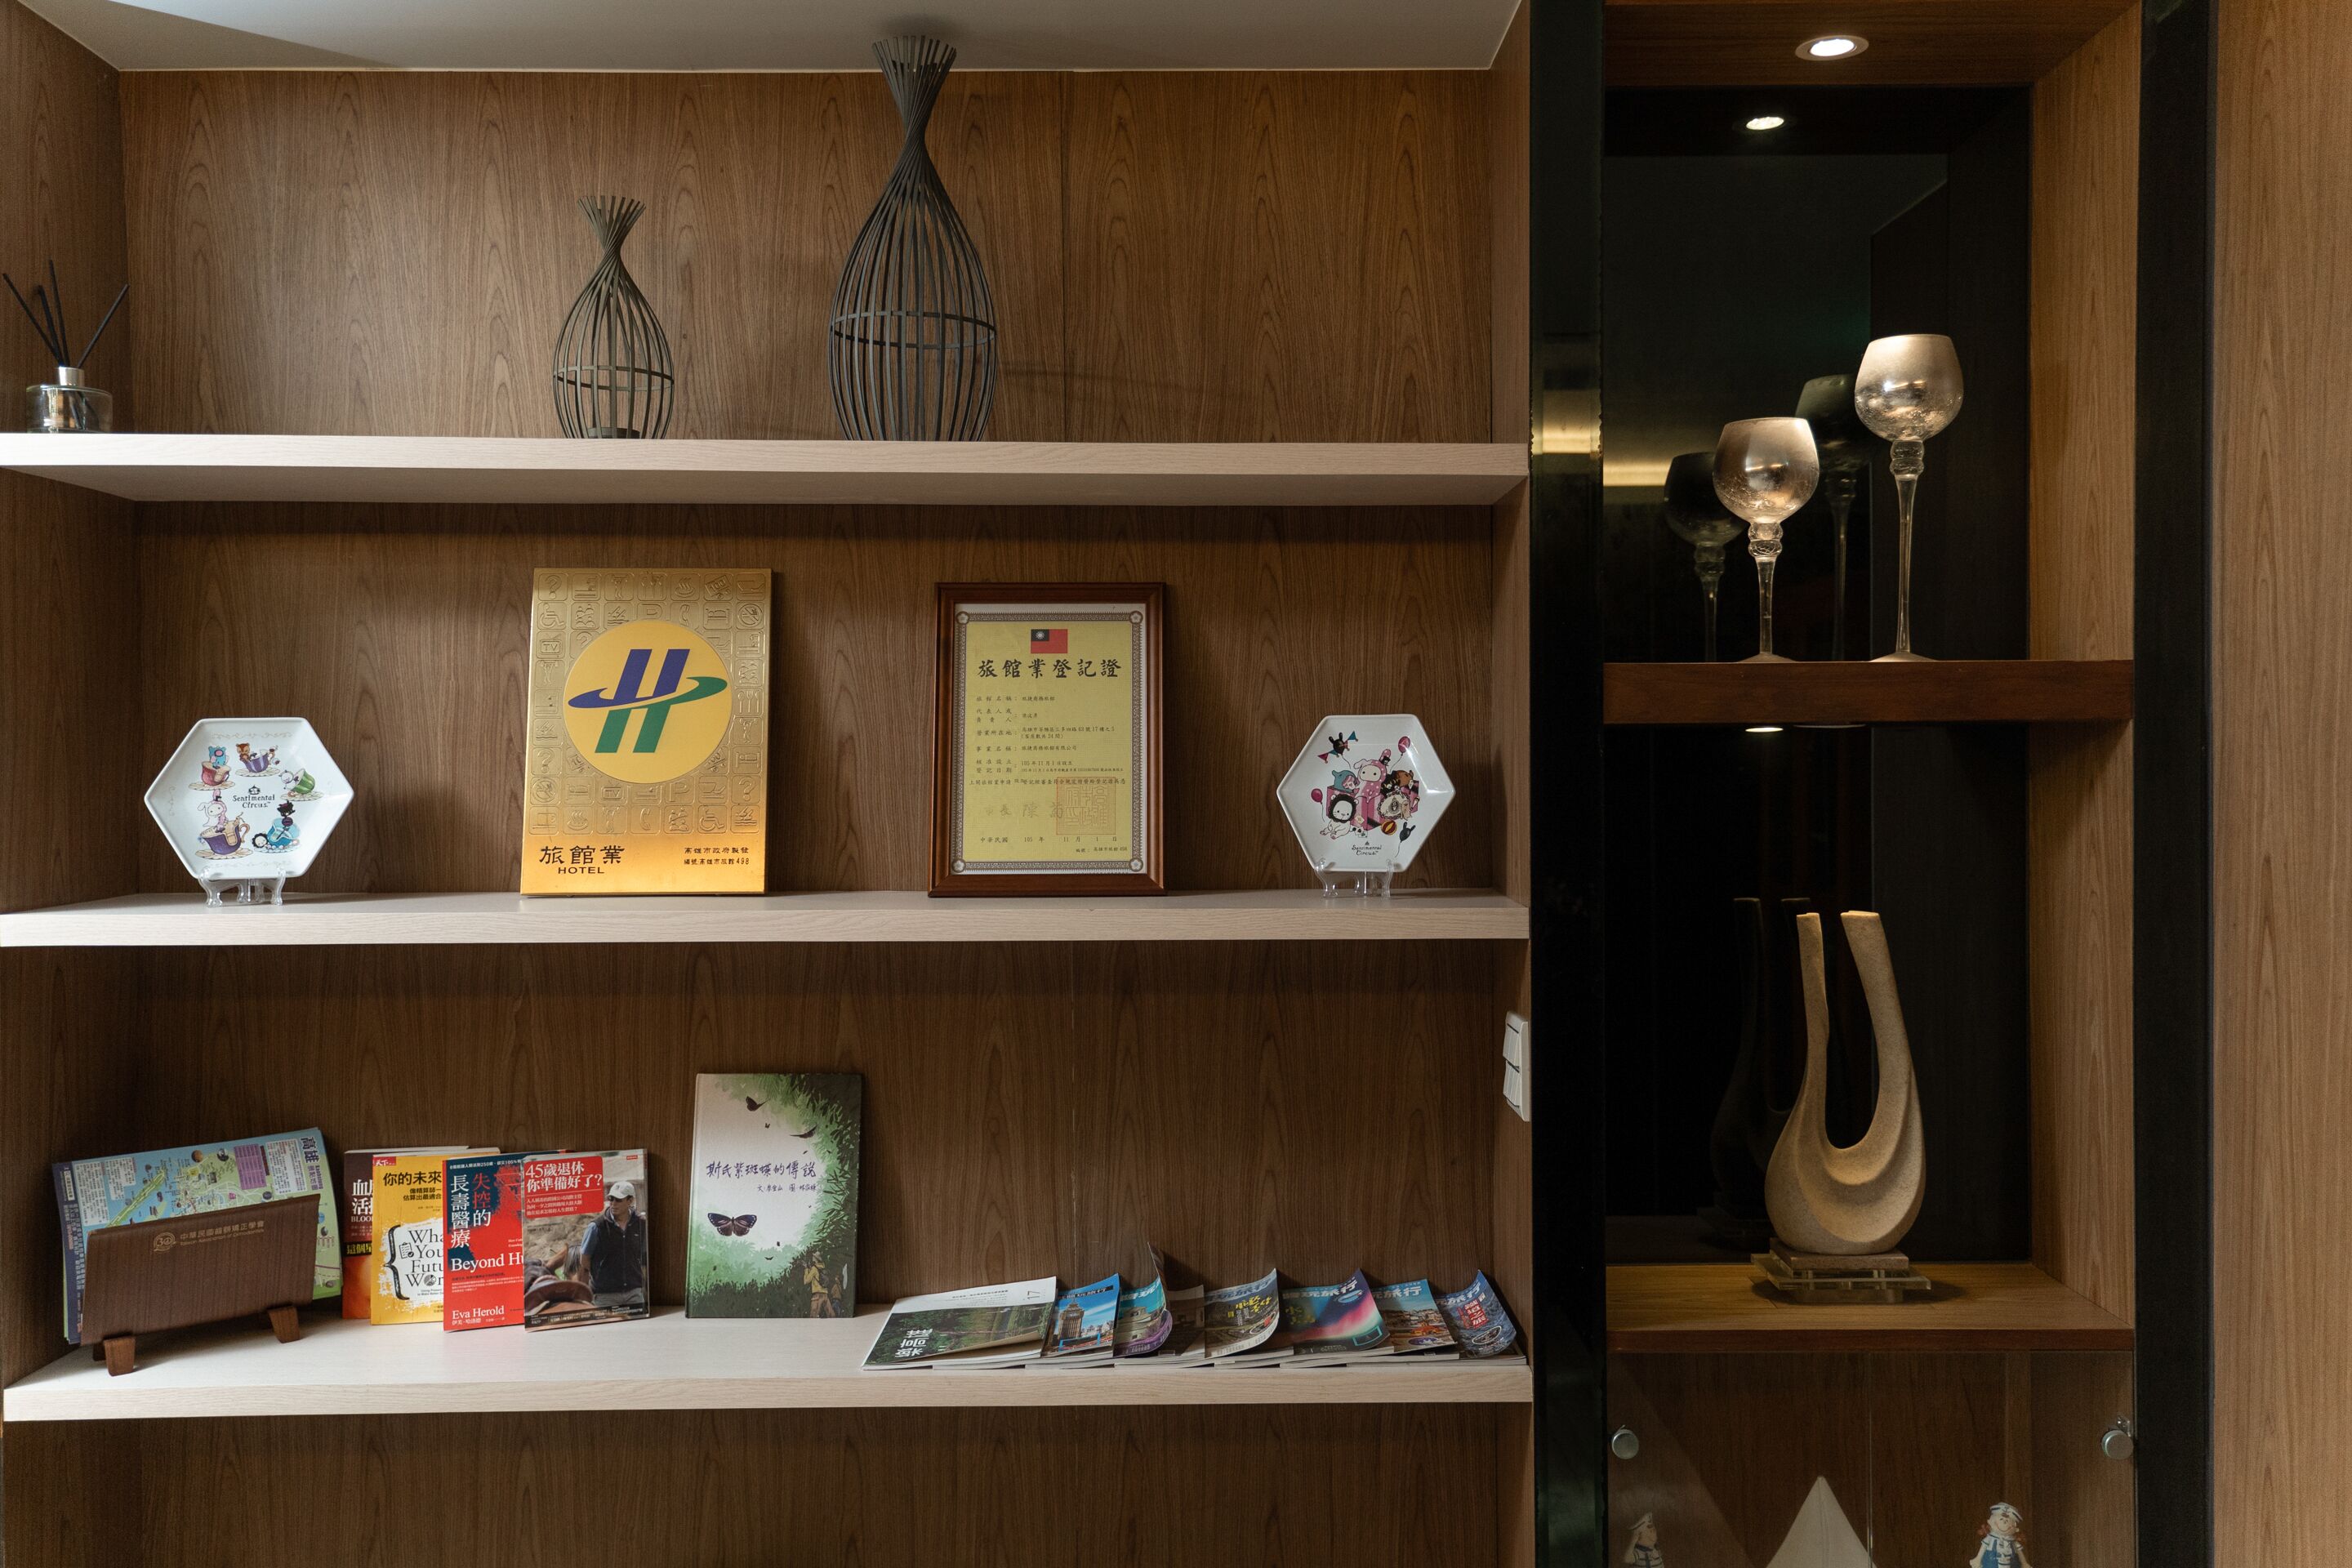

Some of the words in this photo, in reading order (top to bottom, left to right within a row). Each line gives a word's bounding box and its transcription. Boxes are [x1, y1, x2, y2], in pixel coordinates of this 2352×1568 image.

[978, 658, 1121, 679] 旅館業登記證
[232, 794, 275, 802] Sentimental
[538, 845, 625, 864] 旅館業
[558, 866, 605, 875] HOTEL
[300, 1136, 319, 1164] 高雄
[383, 1170, 443, 1187] 你的未來
[525, 1160, 585, 1178] 45歲退休
[706, 1160, 817, 1179] 斯氏紫斑蝶的傳說
[472, 1172, 492, 1227] 失控的
[350, 1214, 373, 1223] BLOO
[450, 1174, 470, 1249] 長壽醫療
[451, 1253, 505, 1272] Beyond
[1282, 1279, 1358, 1299] 玩旅行
[452, 1309, 470, 1320] Eva
[473, 1305, 505, 1317] Herold
[894, 1328, 933, 1357] 樂高雄
